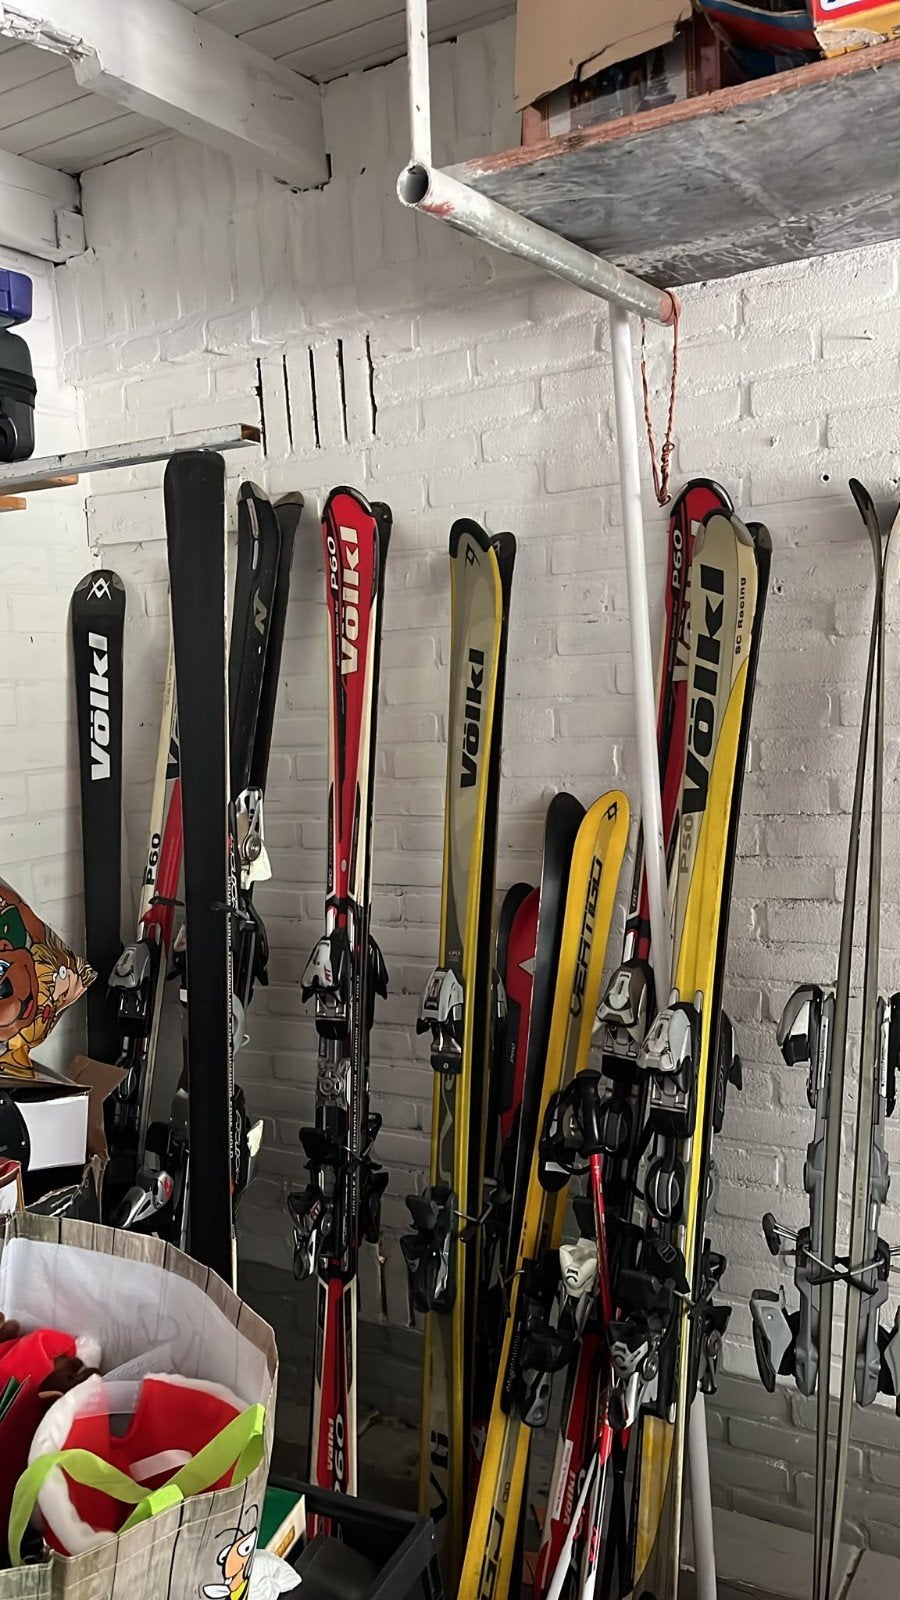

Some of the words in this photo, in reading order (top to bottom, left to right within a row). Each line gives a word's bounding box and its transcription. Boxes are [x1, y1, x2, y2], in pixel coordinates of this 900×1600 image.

[327, 536, 338, 590] P60
[672, 529, 683, 589] P60
[340, 525, 359, 675] Völkl
[737, 577, 746, 629] Racing
[735, 633, 742, 654] SC
[88, 632, 111, 781] Völkl
[460, 648, 485, 788] Völkl
[682, 564, 724, 815] Völkl
[147, 832, 161, 886] P60
[680, 815, 694, 874] P50
